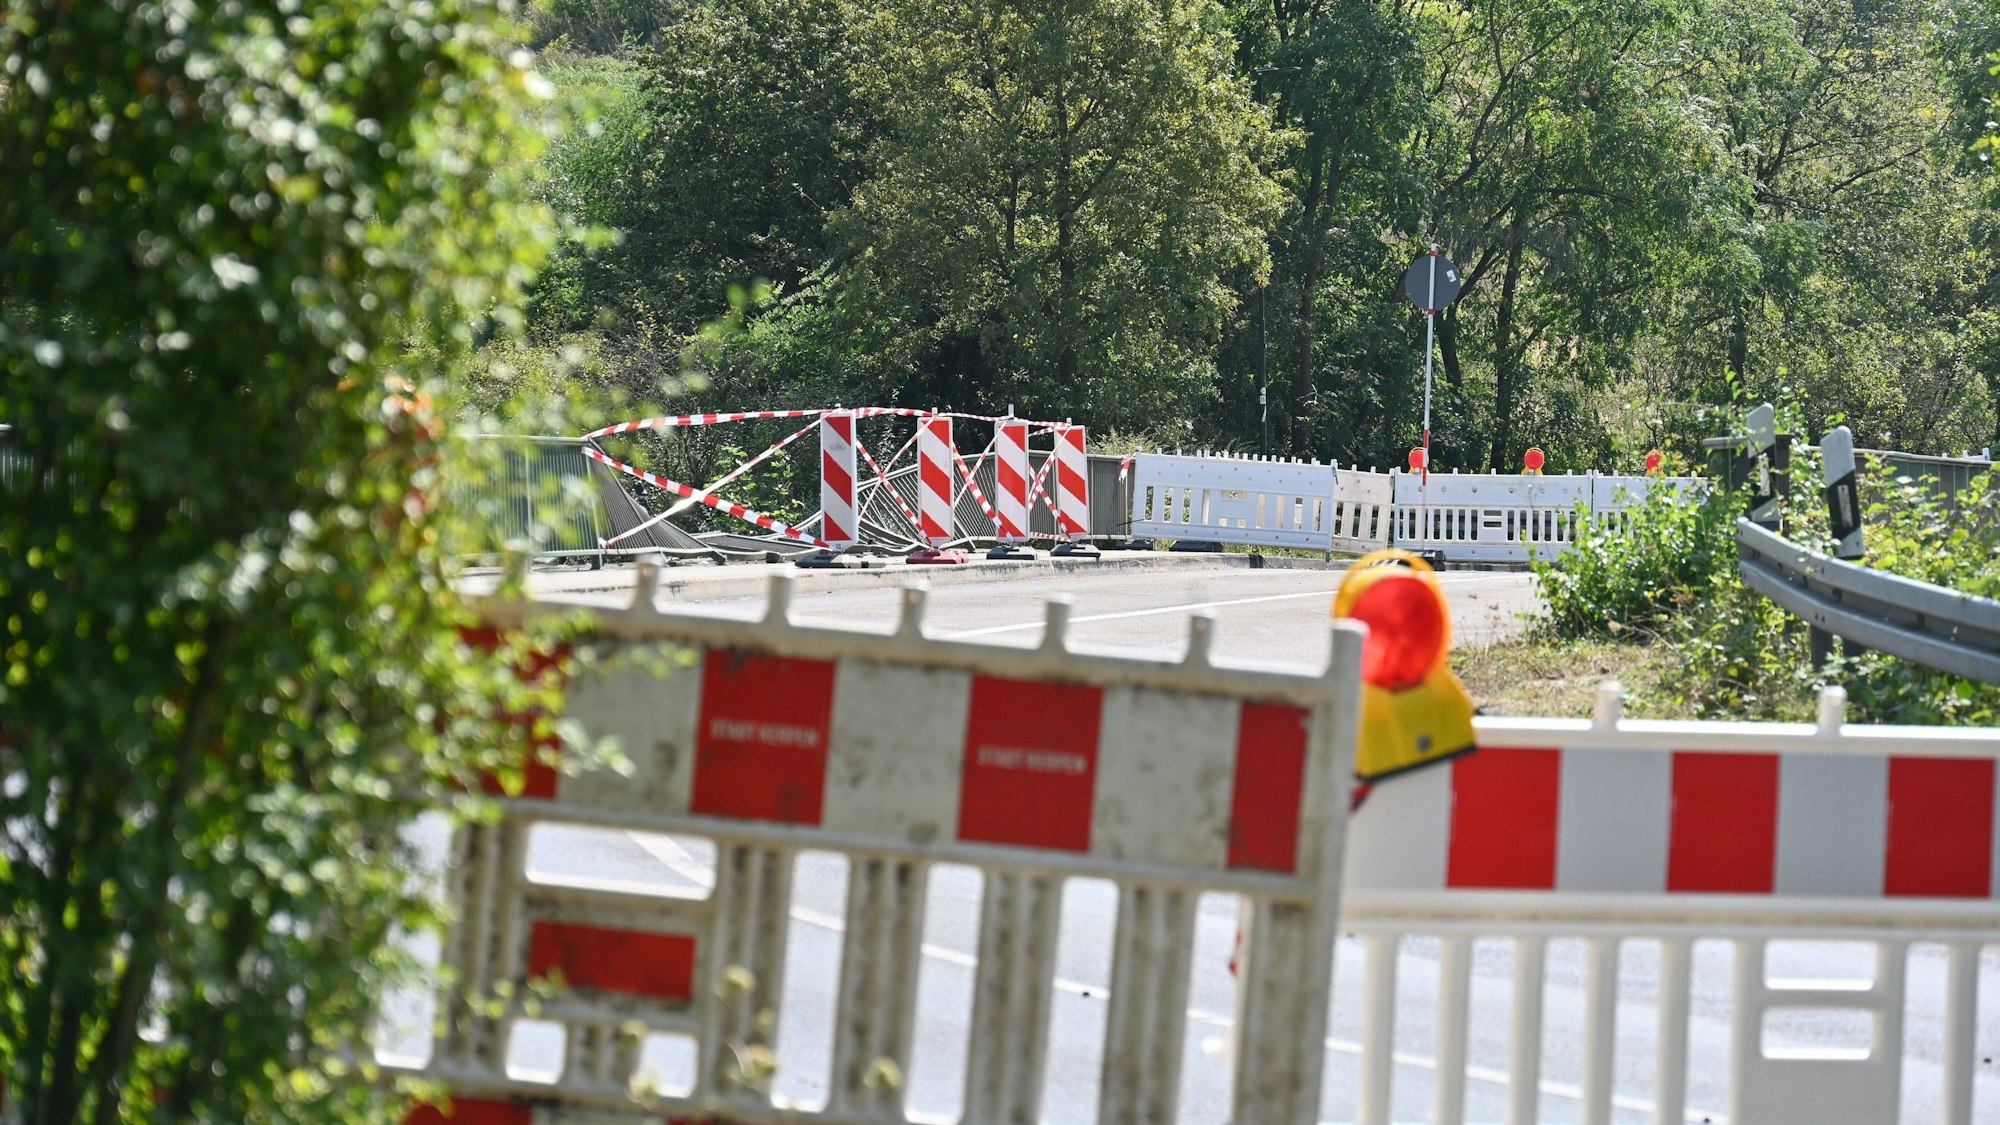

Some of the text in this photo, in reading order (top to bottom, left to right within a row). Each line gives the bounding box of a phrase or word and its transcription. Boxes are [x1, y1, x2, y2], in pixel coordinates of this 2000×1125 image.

[710, 720, 818, 748] STADT KERPEN
[977, 746, 1086, 775] STADT KERPEN
